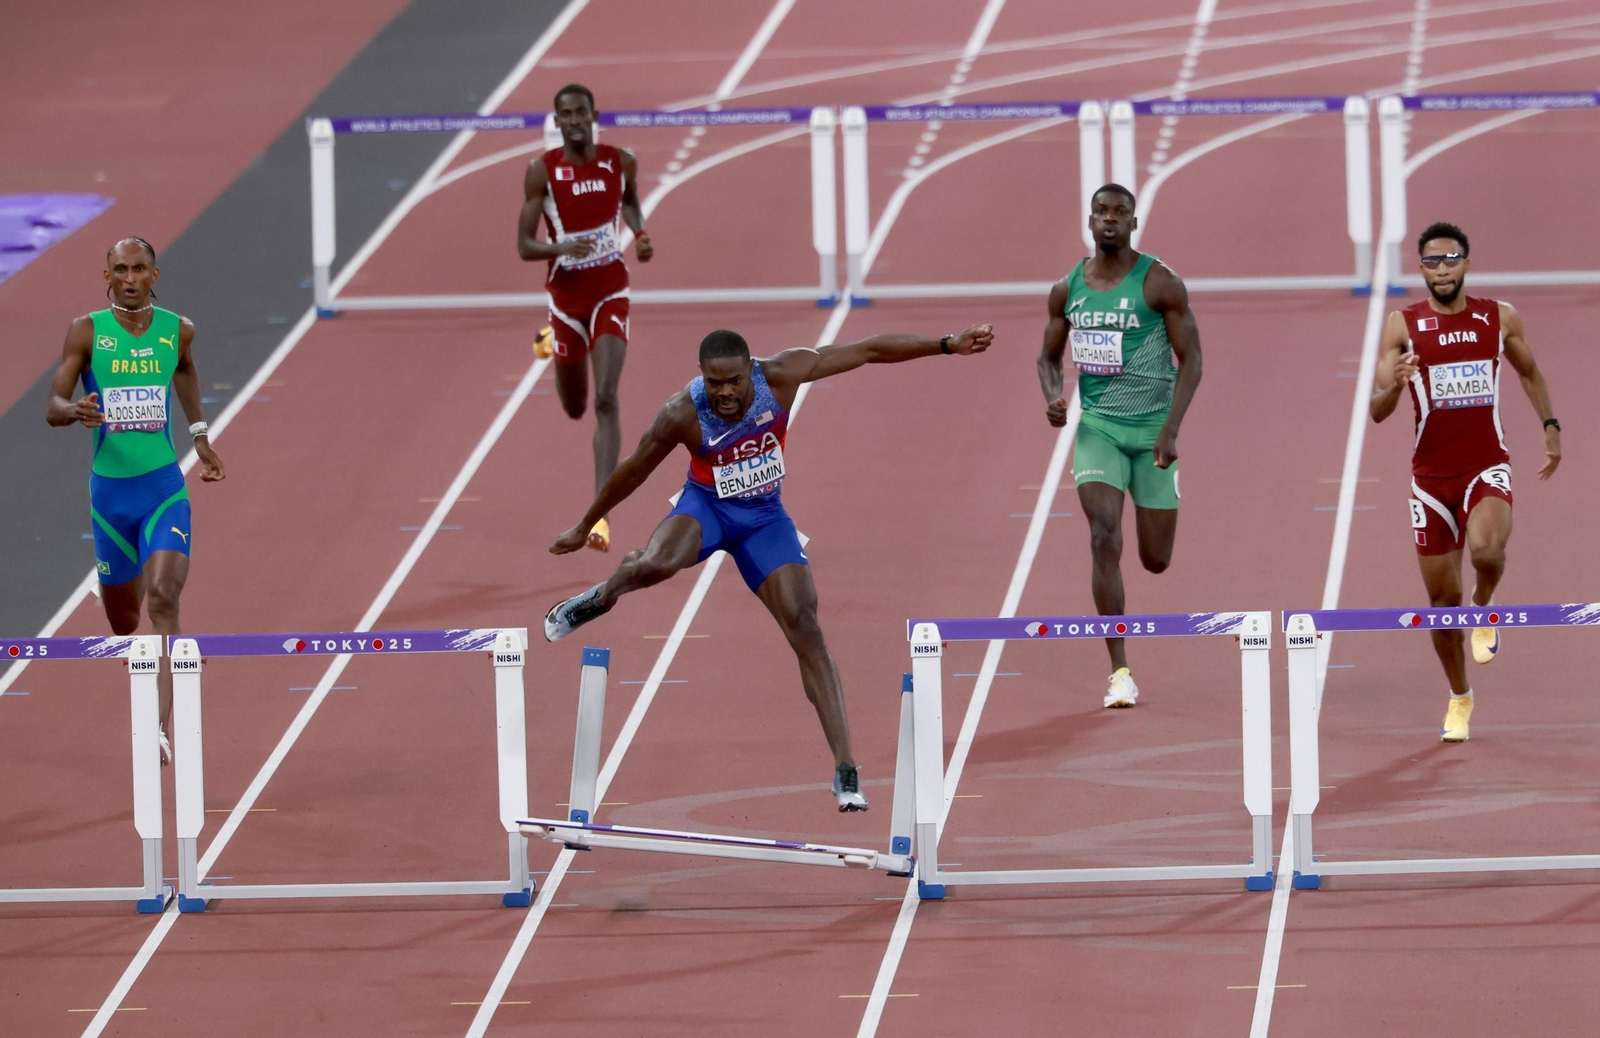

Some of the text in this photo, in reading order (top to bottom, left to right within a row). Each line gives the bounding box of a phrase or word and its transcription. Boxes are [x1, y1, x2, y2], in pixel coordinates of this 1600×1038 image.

[350, 116, 525, 132] WORLD ATHLETICS CHAMPIONSHIPS
[614, 111, 791, 126] WORLD ATHLETICS CHAMPIONSHIPS
[572, 180, 607, 196] QATAR
[1065, 311, 1141, 329] NIGERIA
[1082, 332, 1117, 347] TDK
[1438, 331, 1478, 346] QATAR
[1074, 347, 1120, 363] NATHANIEL
[111, 359, 162, 374] BRASIL
[1446, 363, 1488, 378] TDK
[120, 388, 162, 402] TDK
[1435, 379, 1491, 397] SAMBA
[135, 404, 165, 420] SANTOS
[733, 448, 778, 473] TDK
[719, 462, 782, 496] BENJAMIN
[1491, 473, 1505, 484] 5
[1243, 637, 1268, 646] NISHI
[1289, 636, 1314, 645] NISHI
[914, 644, 939, 654] NISHI
[131, 661, 156, 670] NISHI
[173, 661, 198, 670] NISHI
[496, 654, 521, 663] NISHI
